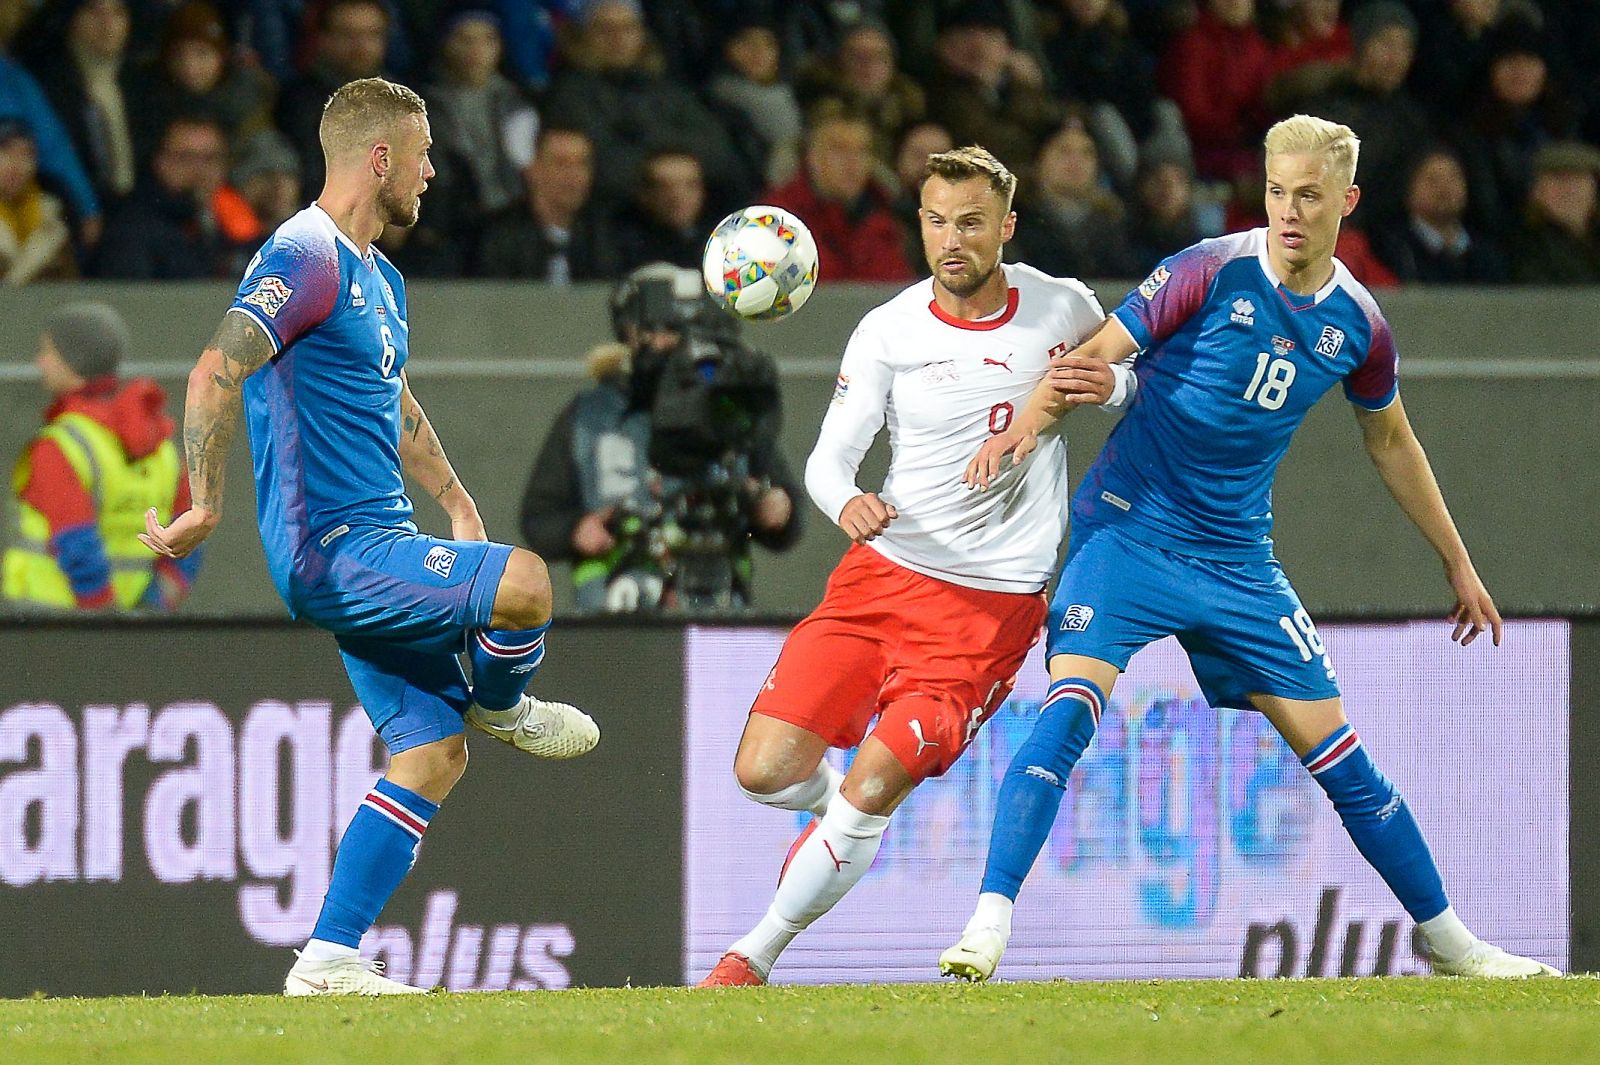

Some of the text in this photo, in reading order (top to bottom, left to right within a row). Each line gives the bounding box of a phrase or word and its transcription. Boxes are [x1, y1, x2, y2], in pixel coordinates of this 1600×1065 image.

[380, 324, 396, 378] 6
[1243, 352, 1297, 411] 18
[1279, 607, 1325, 662] 18
[1238, 886, 1434, 978] plu
